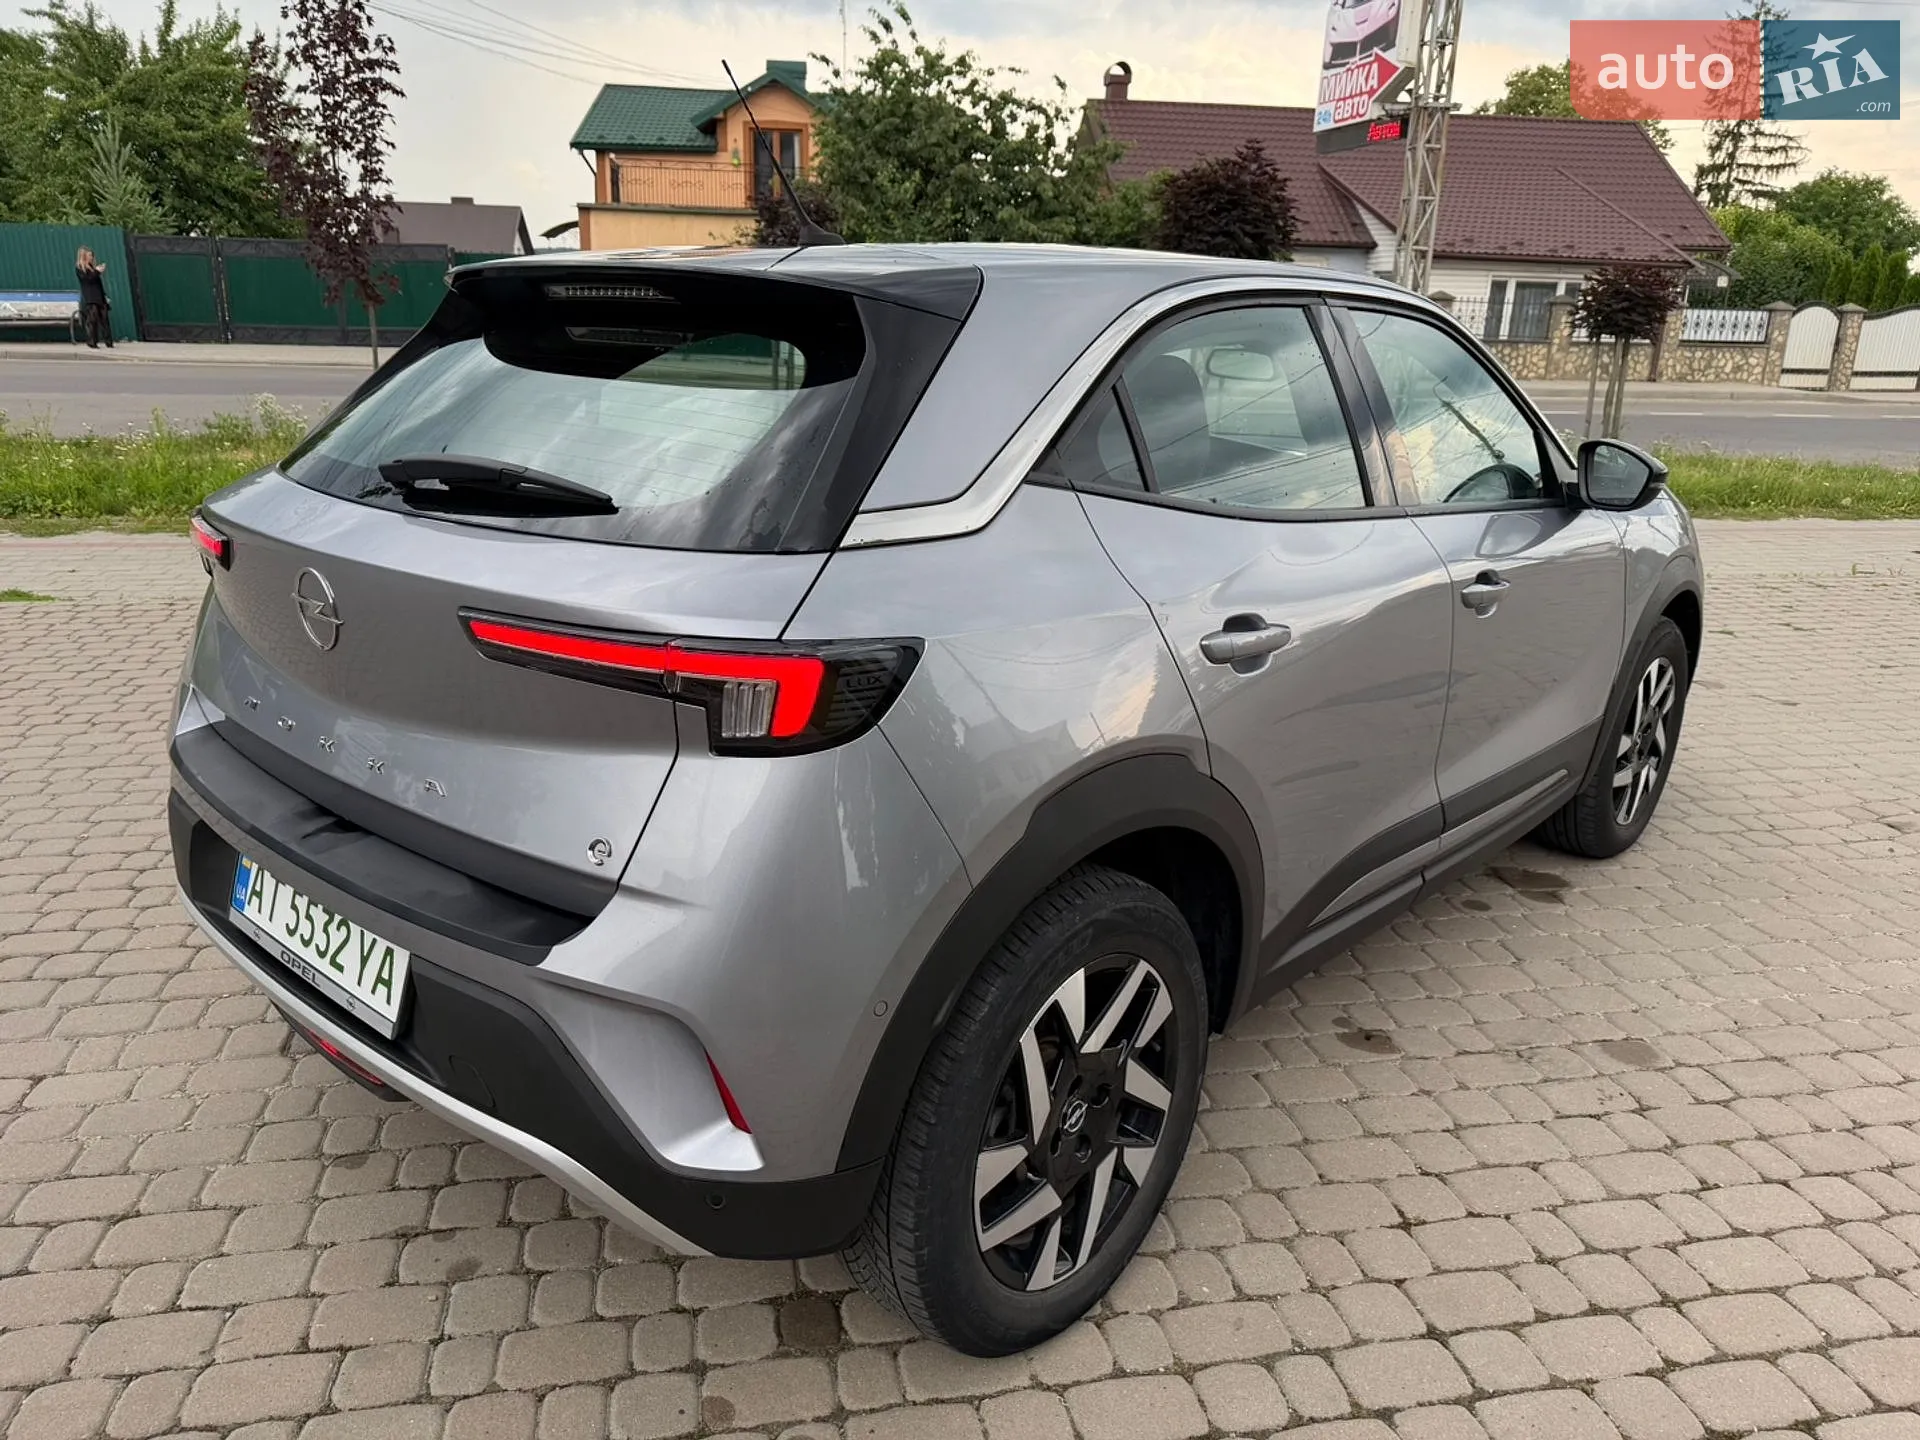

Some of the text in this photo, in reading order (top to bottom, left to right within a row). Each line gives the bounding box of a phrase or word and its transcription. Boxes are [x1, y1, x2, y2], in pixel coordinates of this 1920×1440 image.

[1335, 94, 1369, 121] авто
[248, 867, 395, 1006] AT 5532 YA
[280, 950, 321, 988] OPEL
